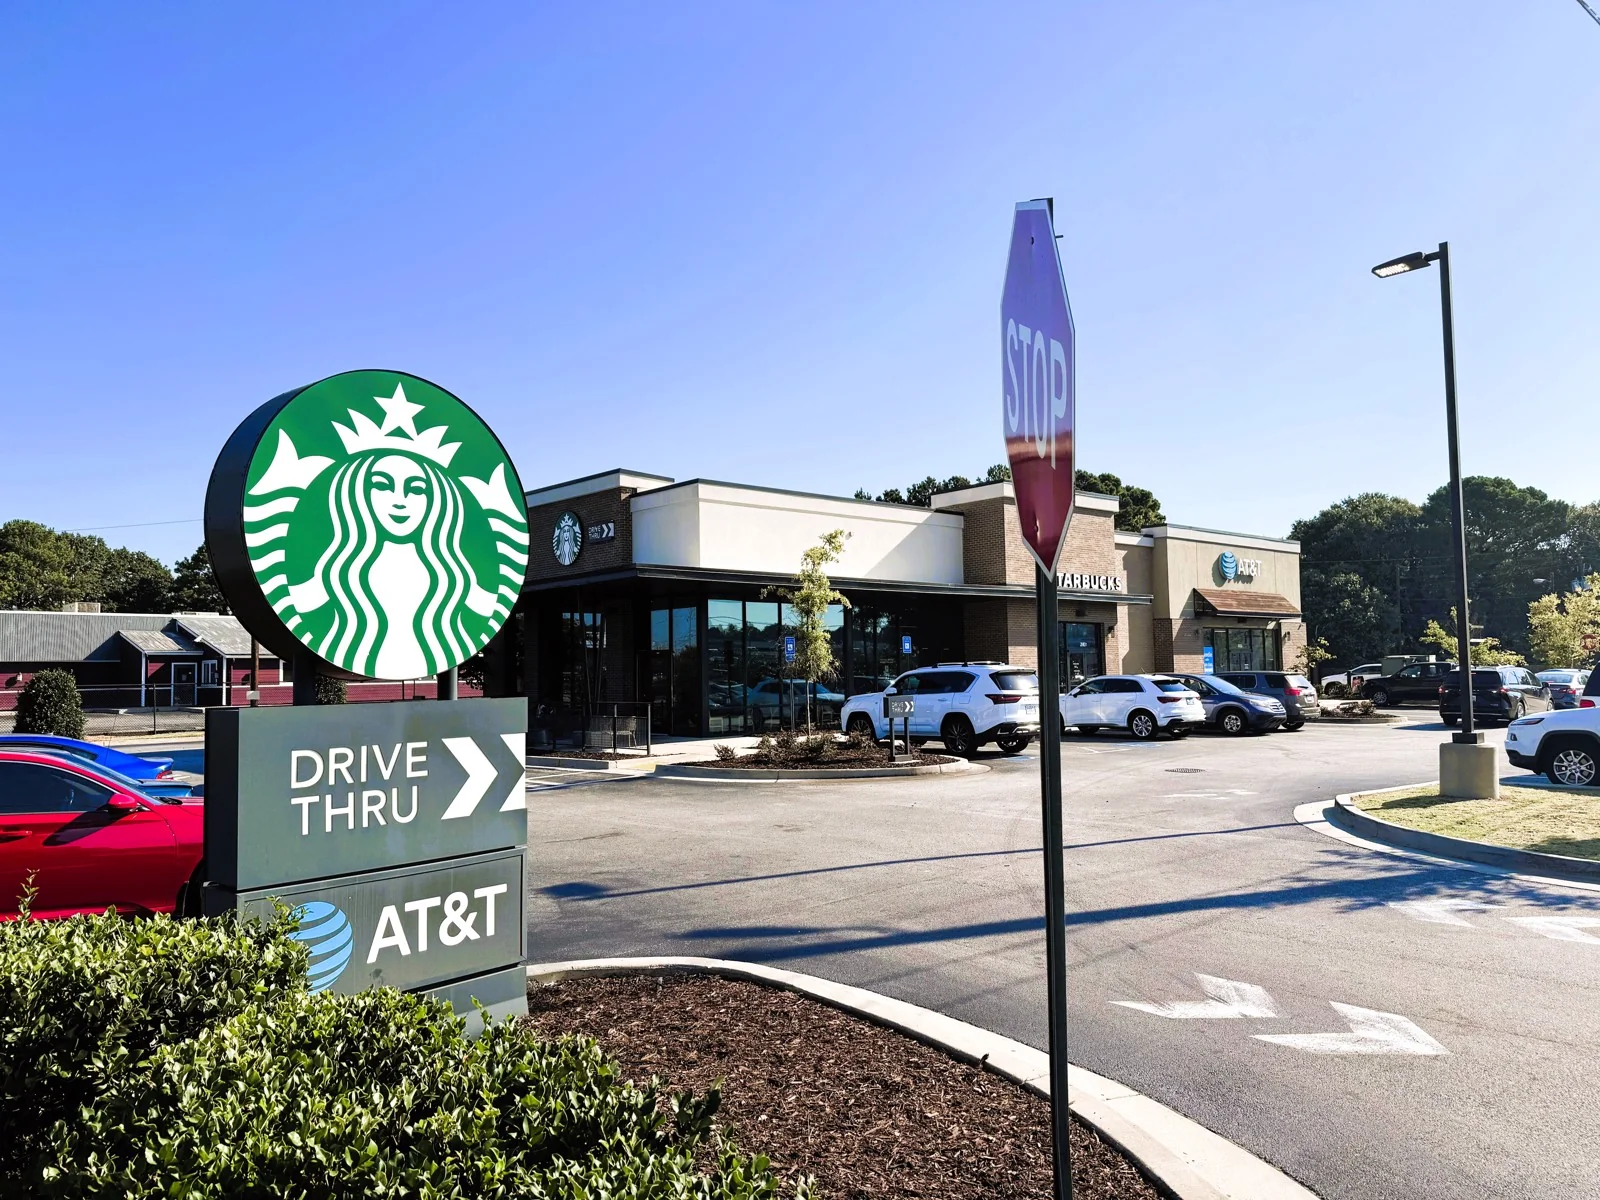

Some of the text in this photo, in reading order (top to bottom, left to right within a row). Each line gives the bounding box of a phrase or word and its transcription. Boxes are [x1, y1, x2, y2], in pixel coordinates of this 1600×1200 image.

[1006, 318, 1067, 470] STOP
[1057, 572, 1122, 591] TARBUCKS
[1238, 558, 1262, 576] AT&T
[290, 741, 428, 789] DRIVE
[290, 785, 418, 836] THRU
[366, 883, 508, 964] AT&T
